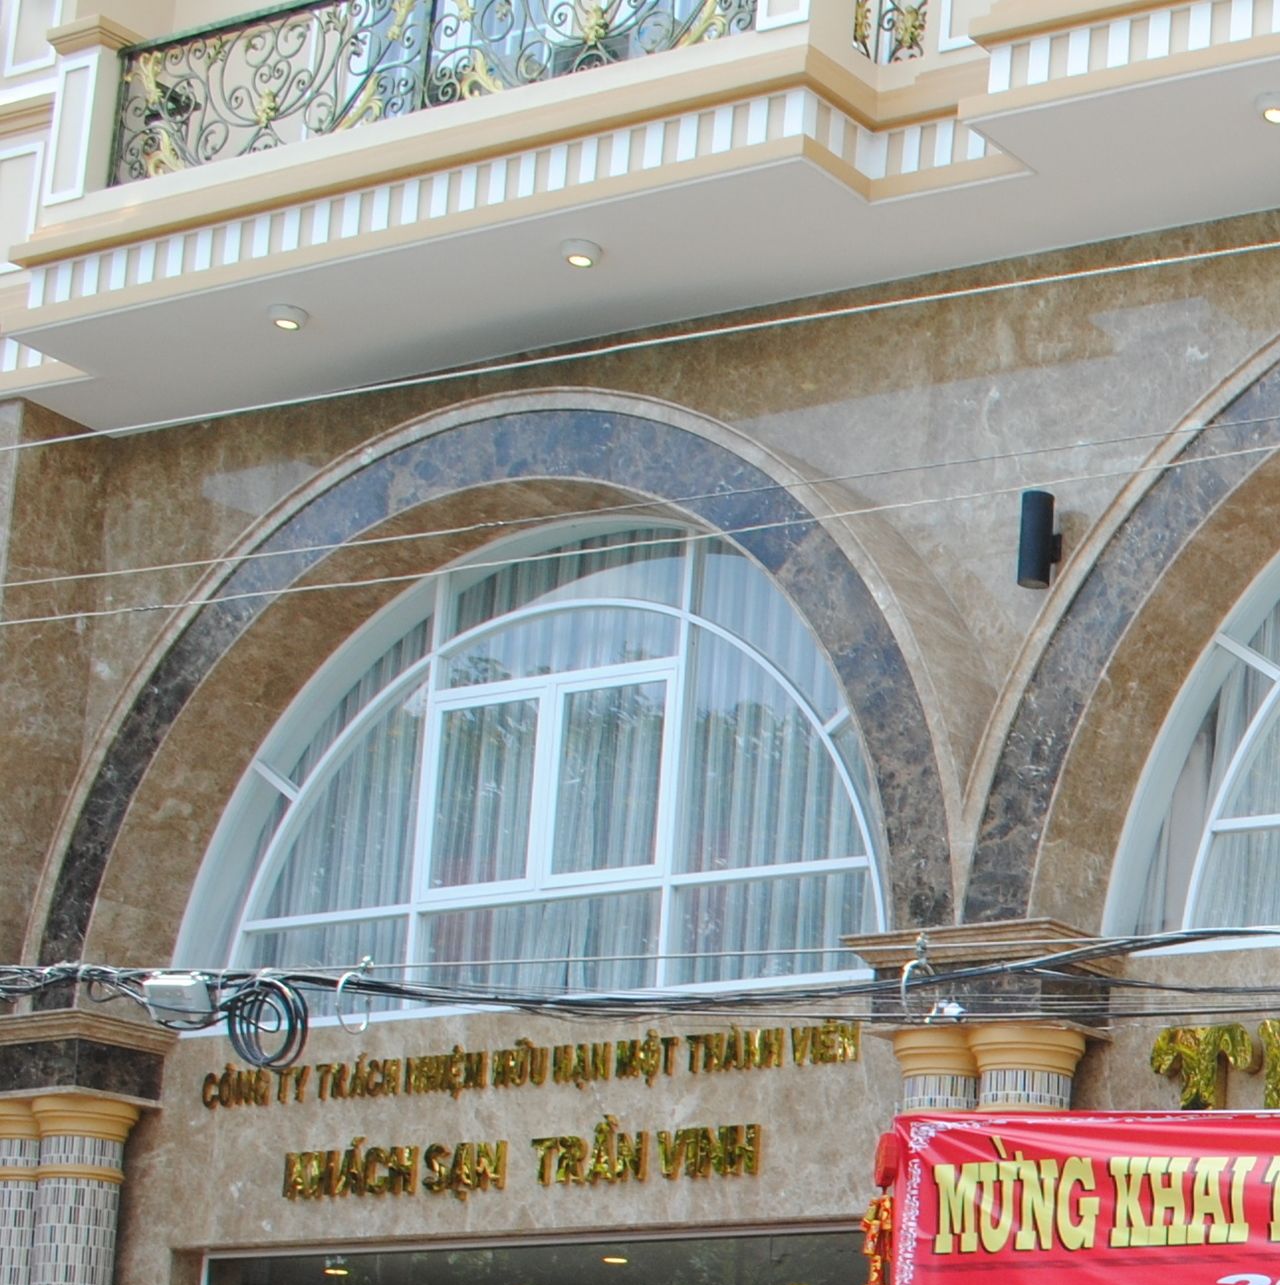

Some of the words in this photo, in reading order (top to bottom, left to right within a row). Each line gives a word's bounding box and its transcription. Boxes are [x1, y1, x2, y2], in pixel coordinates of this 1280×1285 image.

[202, 1063, 271, 1109] CÔNG
[278, 1066, 311, 1104] TY
[316, 1052, 401, 1101] TRÁCH
[553, 1041, 612, 1089] HẠN
[616, 1029, 680, 1087] MỘT
[686, 1024, 785, 1074] THÀNH
[283, 1137, 419, 1200] KHÁCH
[424, 1140, 508, 1201] SẠN
[531, 1114, 650, 1186] TRẦN
[657, 1124, 761, 1181] VINH
[931, 1136, 1100, 1257] MỪNG
[1106, 1154, 1260, 1249] KHAI
